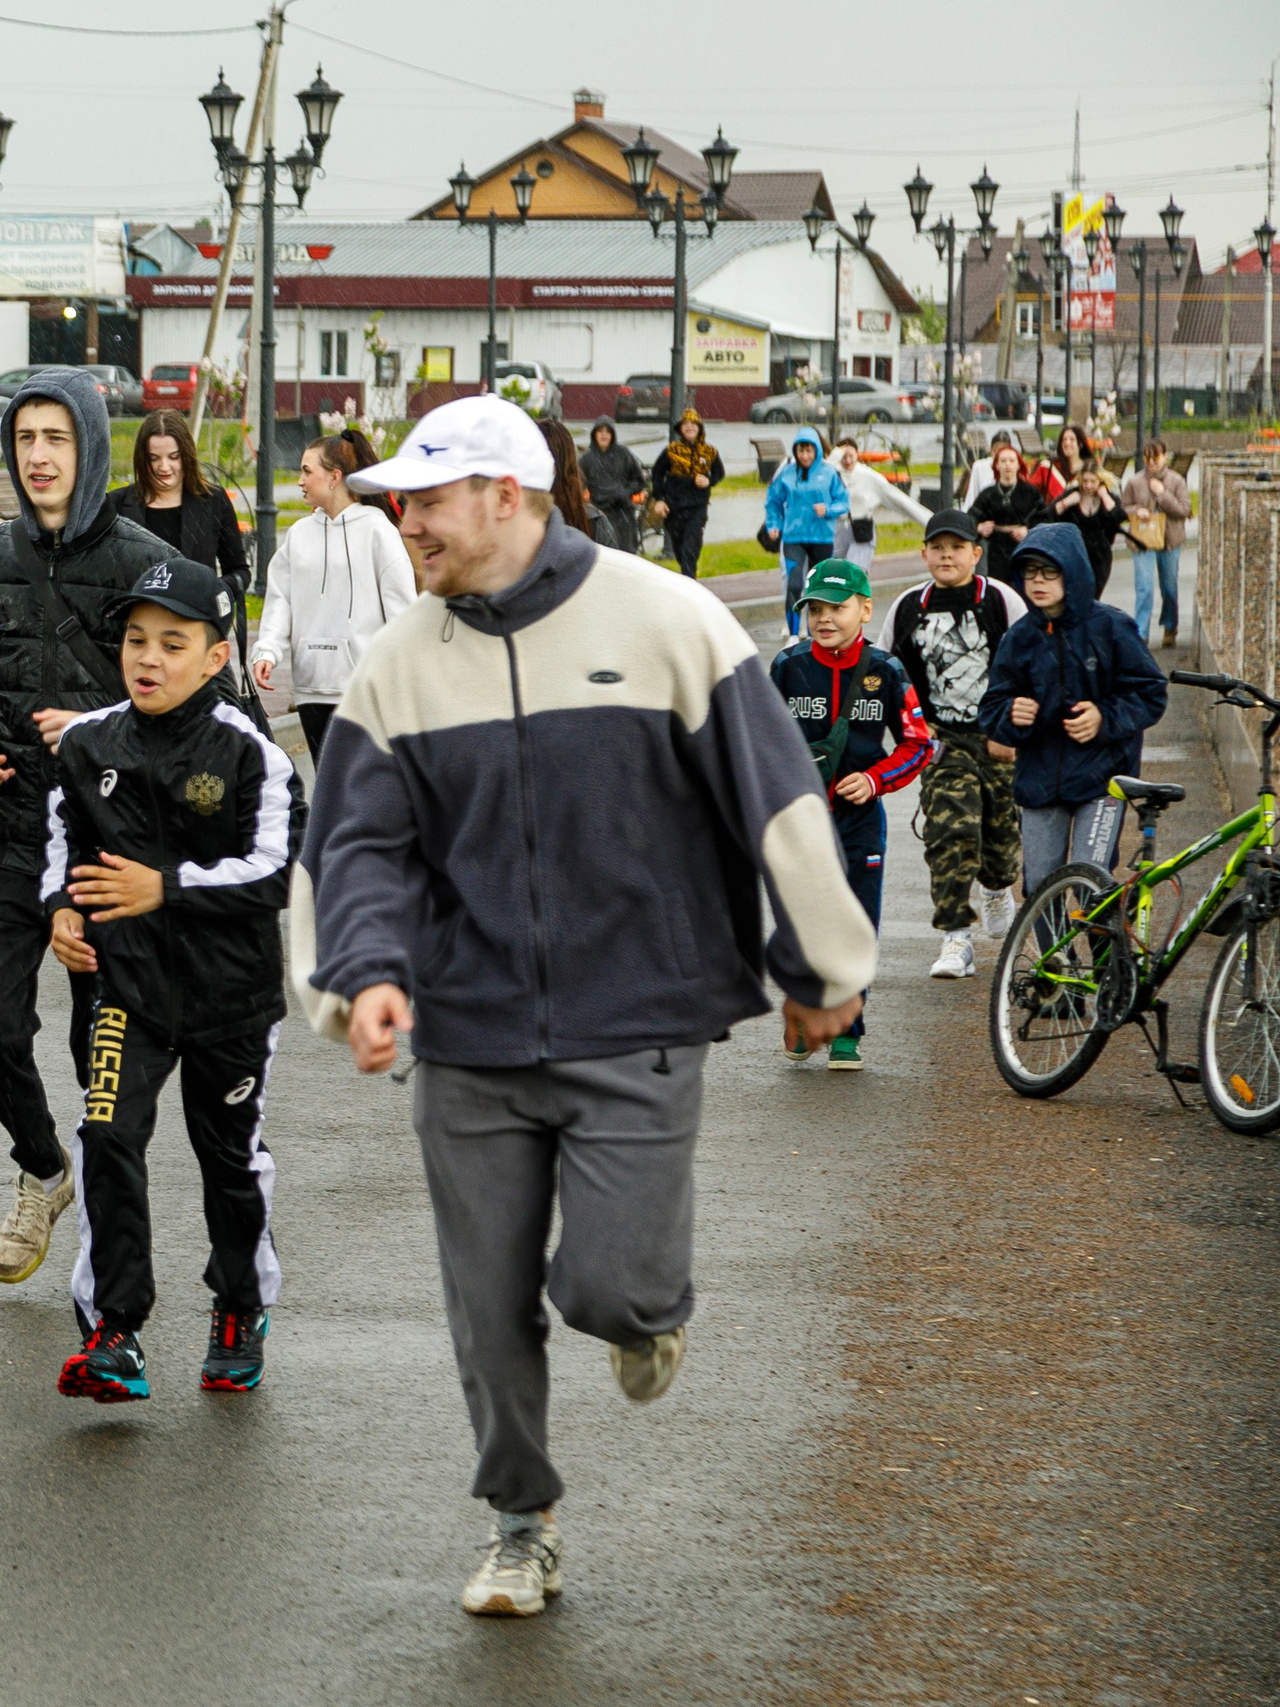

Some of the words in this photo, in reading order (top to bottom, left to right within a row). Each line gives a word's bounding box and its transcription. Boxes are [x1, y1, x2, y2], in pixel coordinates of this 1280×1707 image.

[694, 337, 758, 348] ЗАПРАВКА
[704, 350, 745, 362] АВТО
[823, 576, 846, 585] adidas
[86, 1007, 127, 1122] RUSSIA
